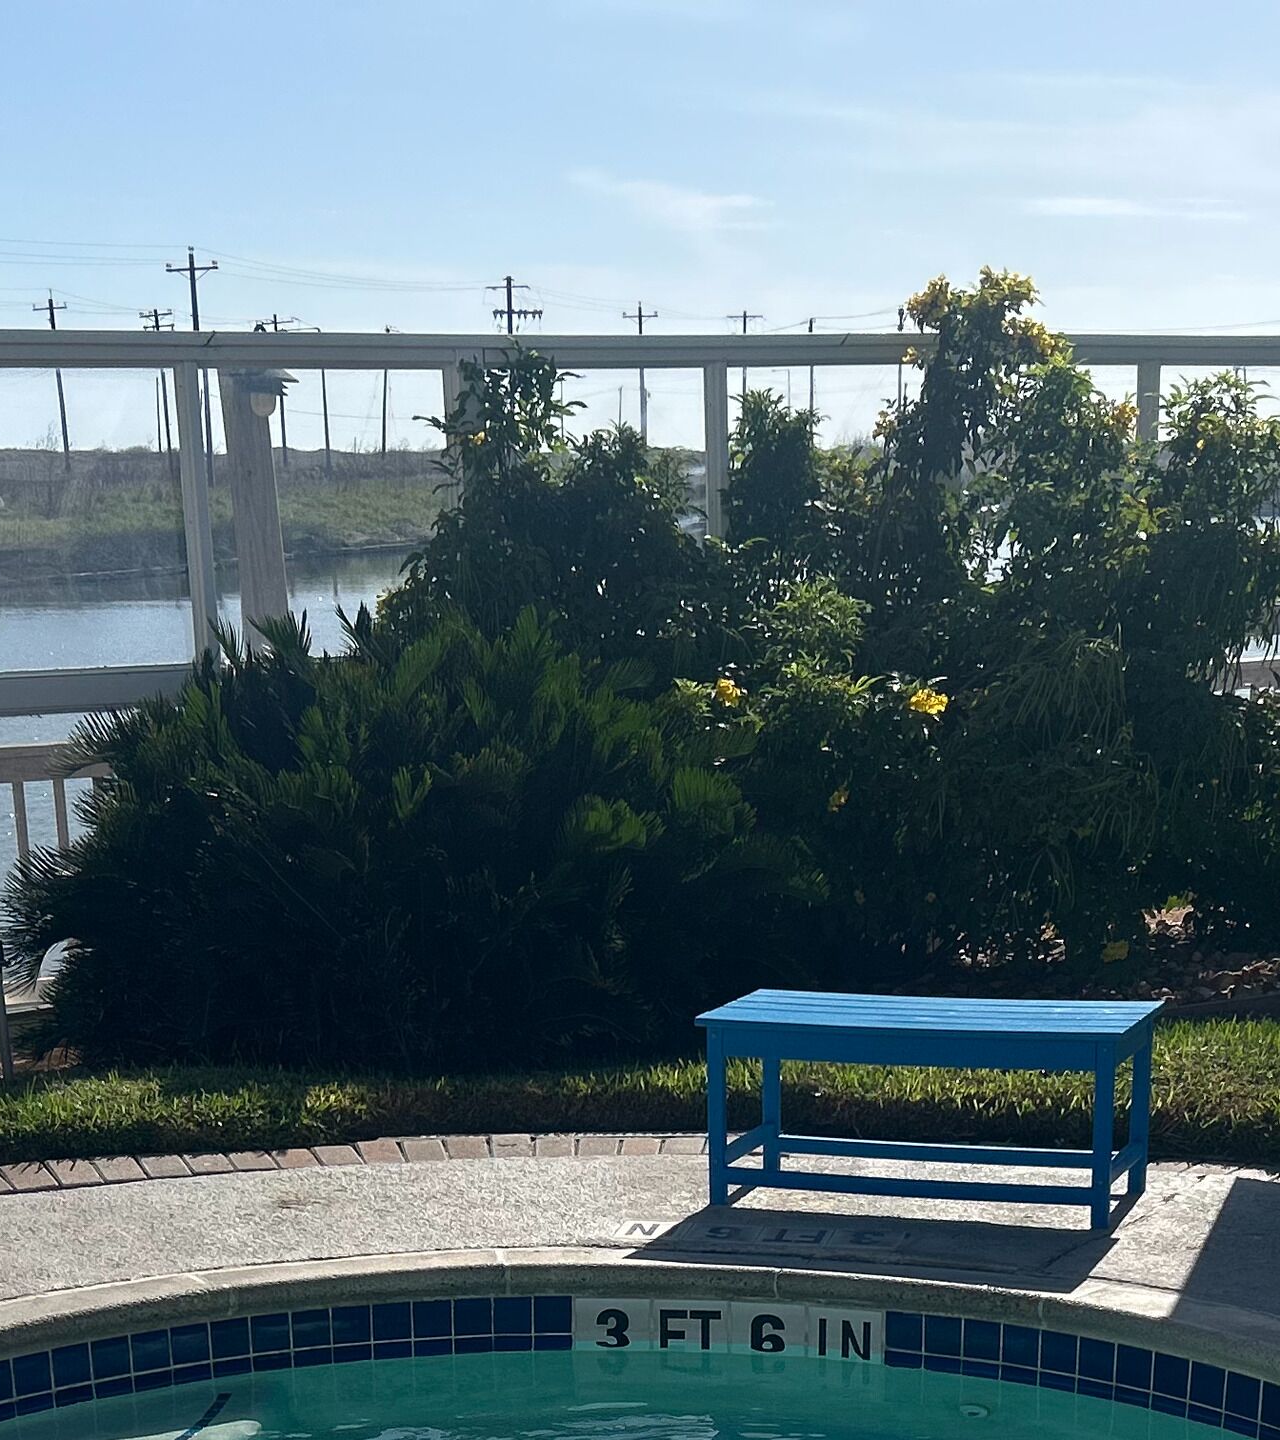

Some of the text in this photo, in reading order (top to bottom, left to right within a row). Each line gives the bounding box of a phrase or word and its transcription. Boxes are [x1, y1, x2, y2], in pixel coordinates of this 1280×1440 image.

[763, 1228, 827, 1245] FT
[595, 1308, 872, 1361] 3 FT 6 IN
